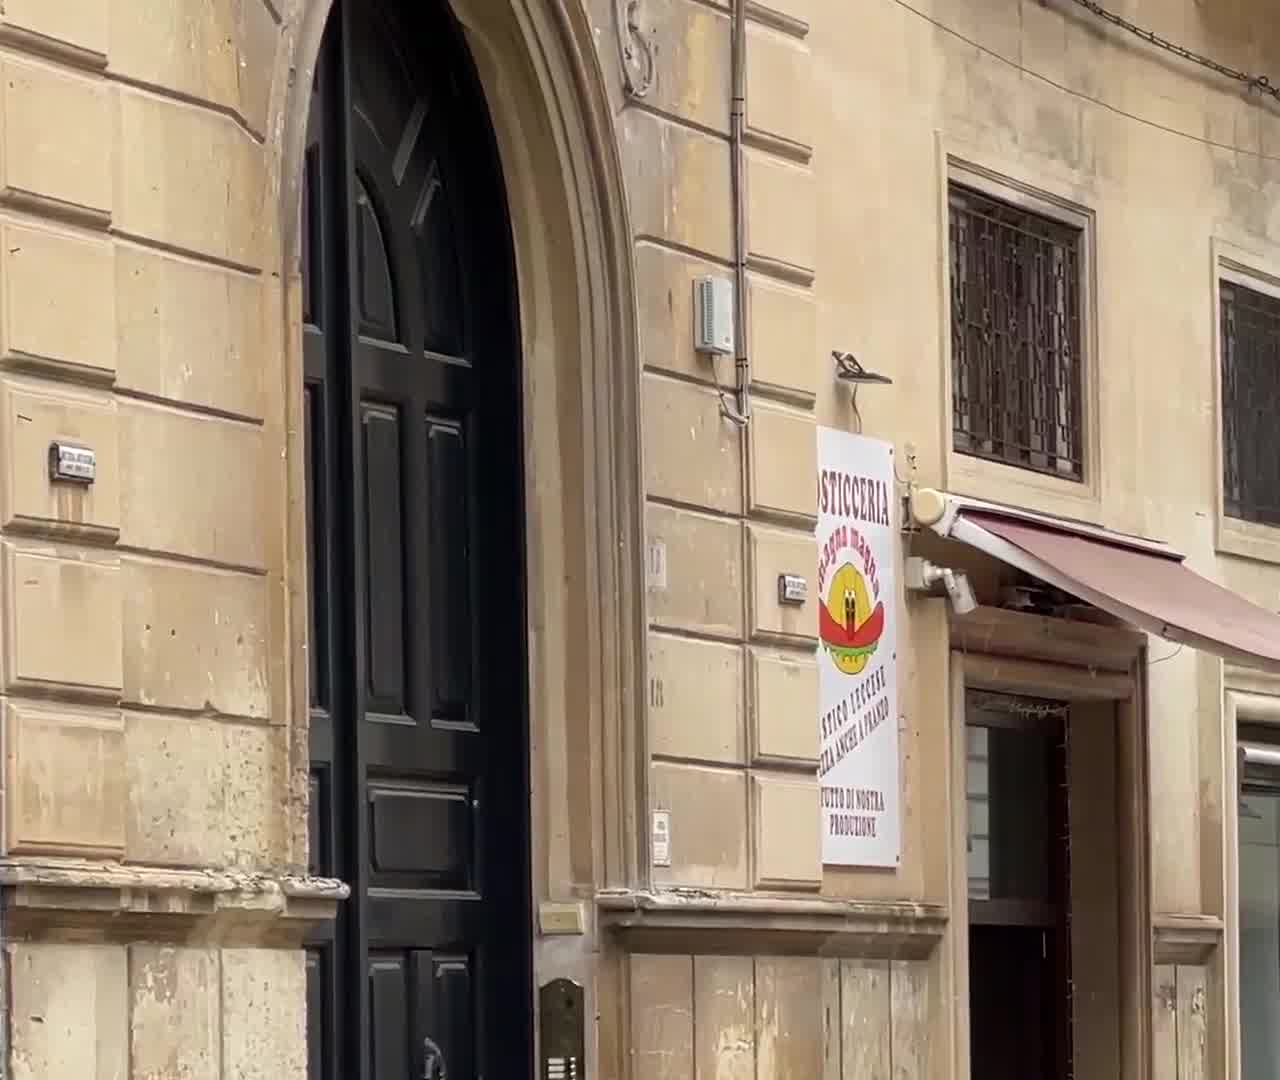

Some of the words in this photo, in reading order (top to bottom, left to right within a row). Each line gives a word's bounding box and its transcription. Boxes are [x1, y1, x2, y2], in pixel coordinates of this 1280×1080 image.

[819, 699, 849, 740] STICO
[849, 665, 887, 715] LECCESE
[835, 722, 859, 762] ANCHE
[864, 695, 889, 737] PRANZO
[820, 786, 845, 809] TUTTO
[845, 788, 855, 810] DI
[855, 789, 885, 812] NOSTRA
[829, 813, 877, 838] PRODUZIONE
